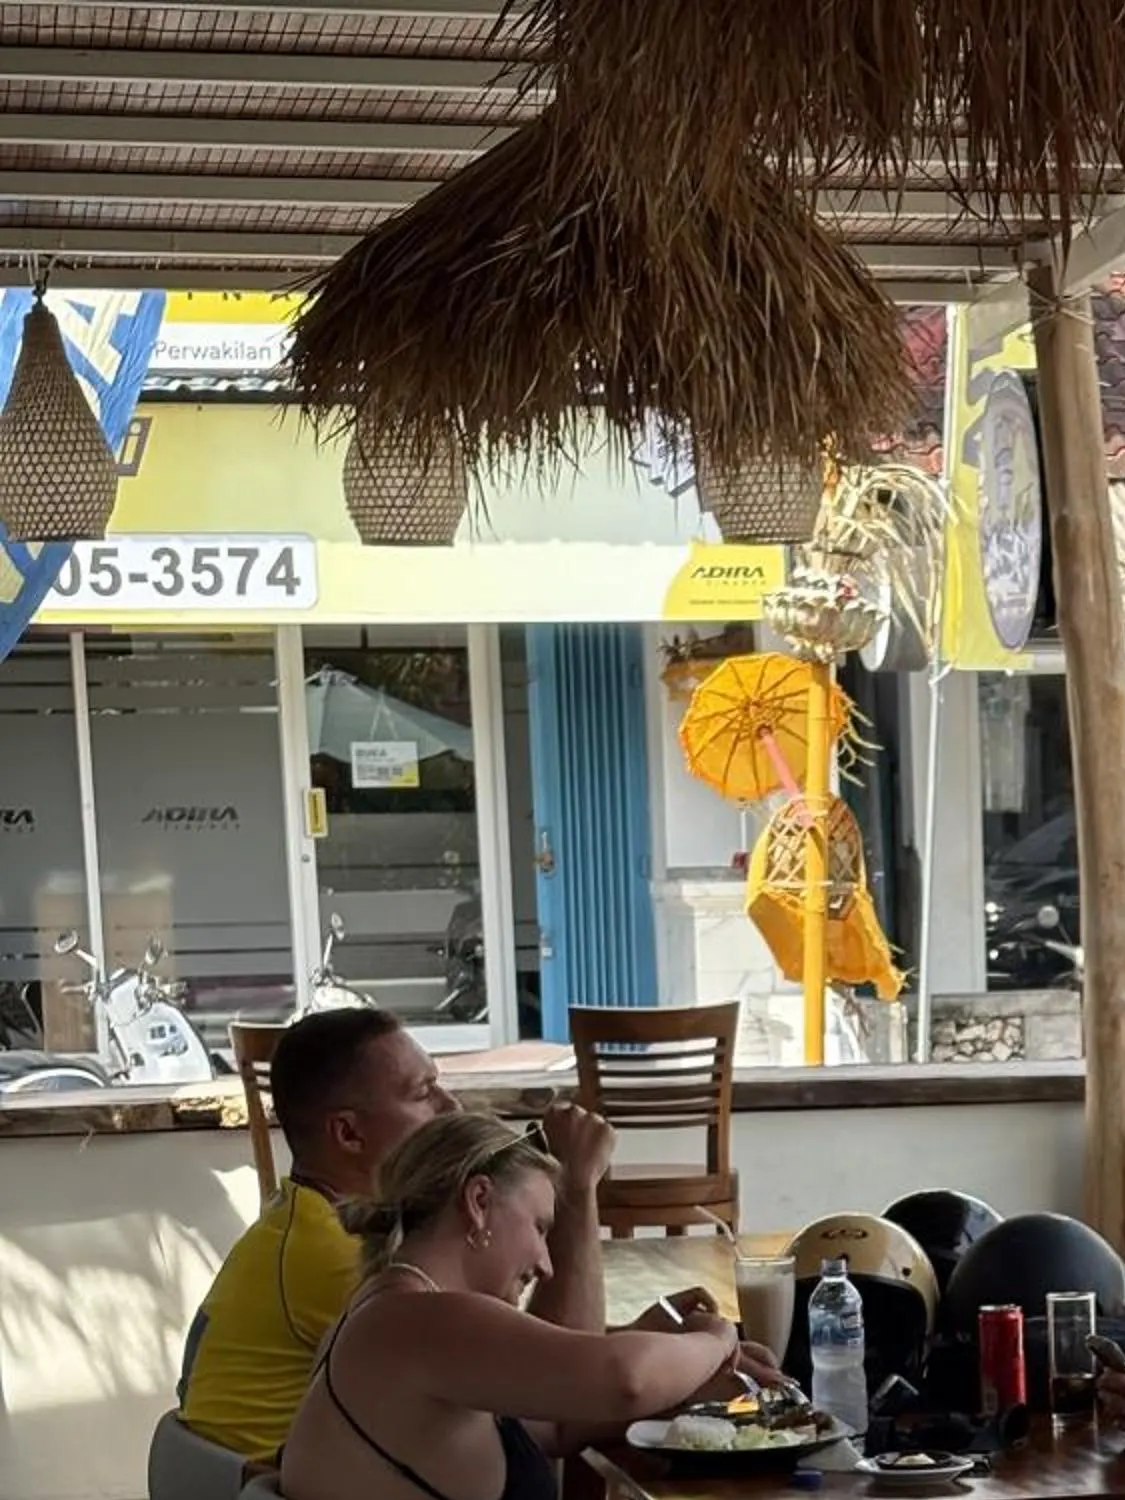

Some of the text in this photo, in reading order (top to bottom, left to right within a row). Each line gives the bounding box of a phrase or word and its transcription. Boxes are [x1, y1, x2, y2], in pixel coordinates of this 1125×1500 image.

[154, 340, 272, 361] Perwakilan
[691, 565, 765, 579] ADIRA
[141, 806, 239, 823] ADIRA
